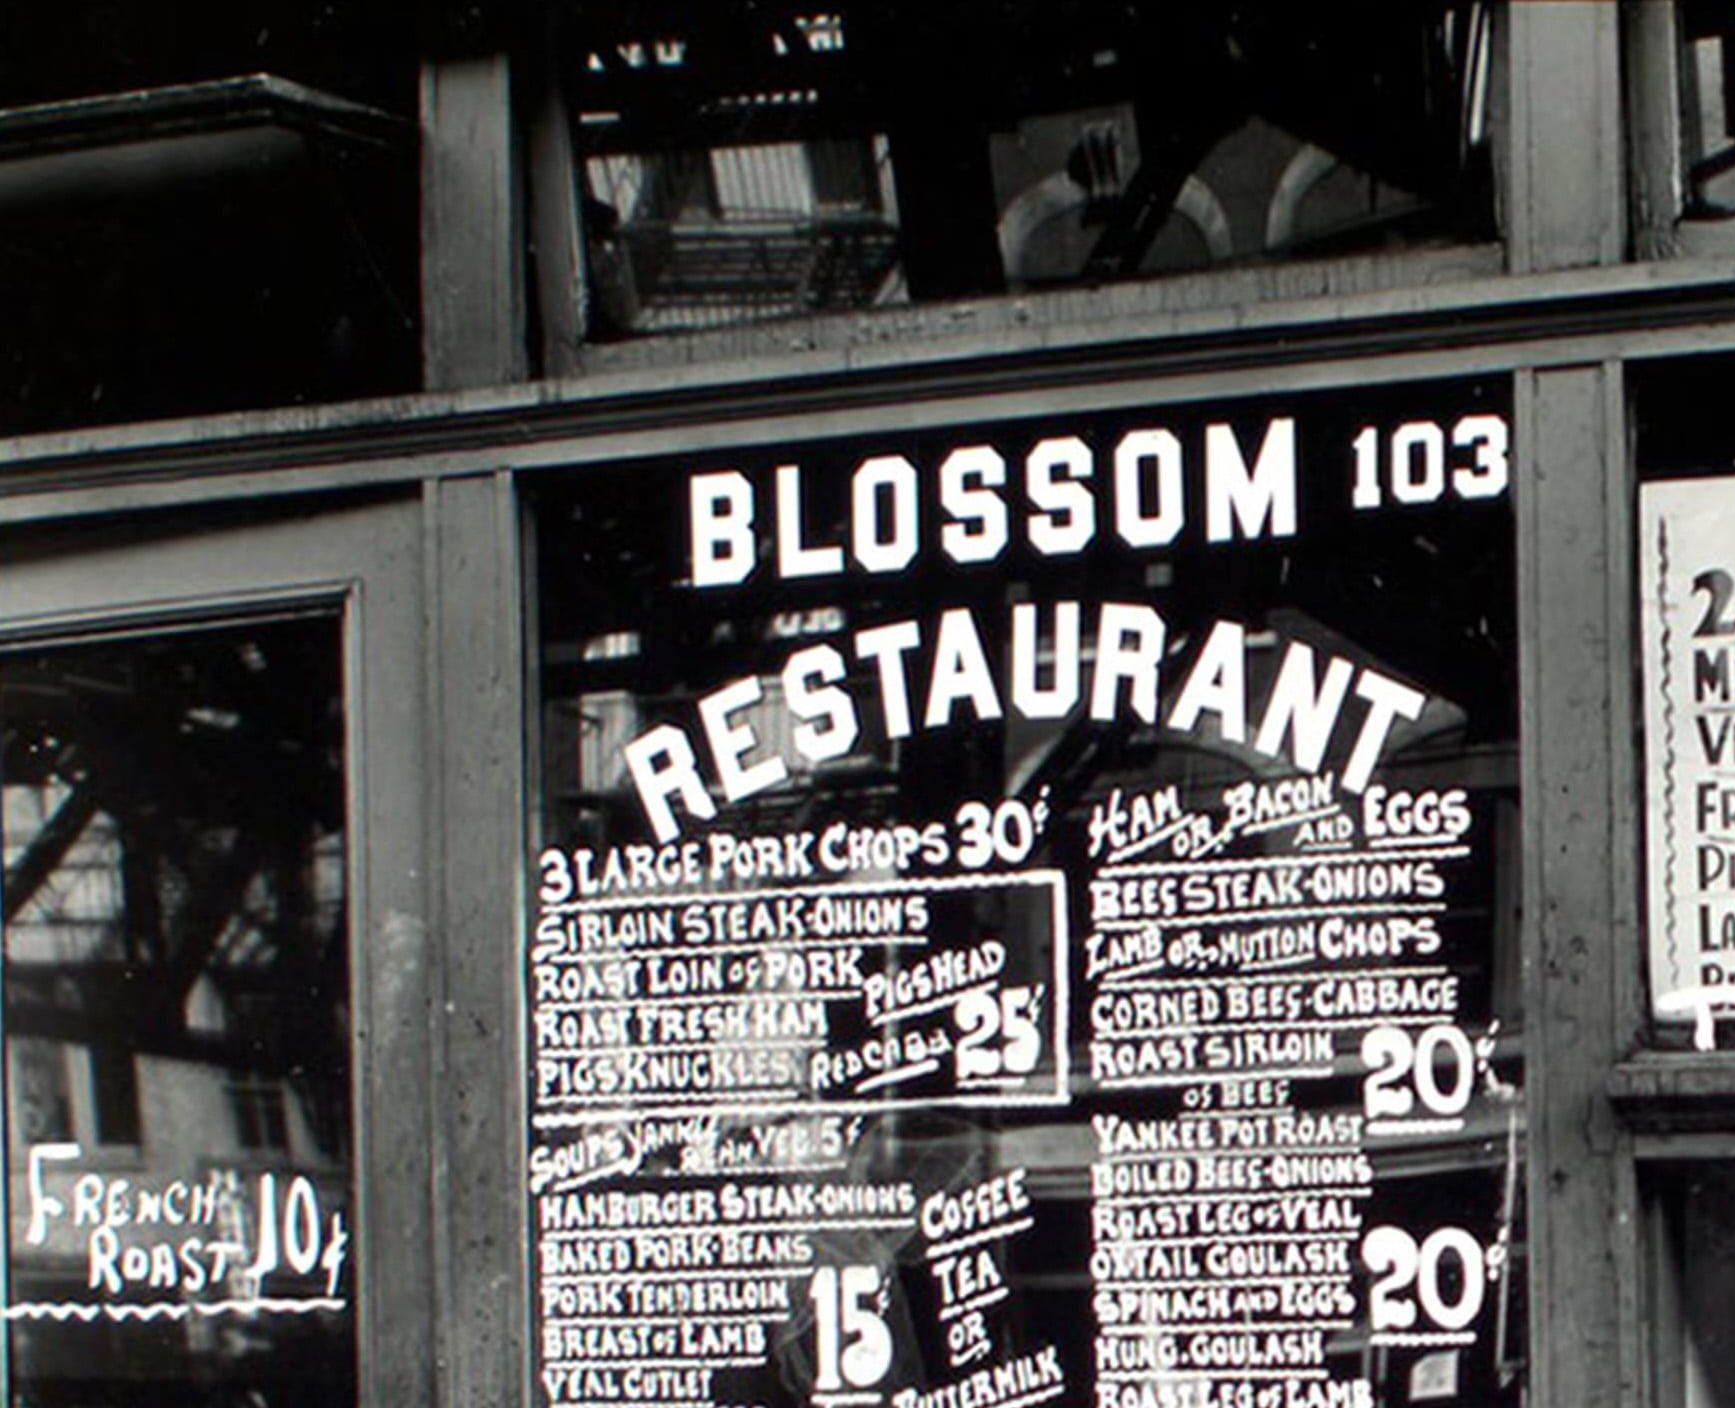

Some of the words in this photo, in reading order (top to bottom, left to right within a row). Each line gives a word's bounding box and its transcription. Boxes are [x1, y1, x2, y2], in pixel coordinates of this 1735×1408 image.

[689, 417, 1297, 587] BLOSSOM
[1353, 415, 1508, 509] 103
[624, 601, 1425, 844] RESTAURANT
[1089, 785, 1181, 857] HAM
[1224, 771, 1335, 830] BACON
[1363, 785, 1471, 836] EGGS
[540, 849, 573, 900] 3
[575, 844, 700, 895] LARGE
[709, 832, 812, 880] PORK
[820, 821, 950, 871] CHOPS
[533, 912, 674, 962] SIRLOIN
[1085, 928, 1162, 980] LAMB
[1219, 922, 1315, 967] MUTTON
[1318, 916, 1442, 959] CHOPS
[534, 957, 640, 1002] ROAST
[648, 955, 721, 992] LOIN
[762, 948, 863, 988] PORK
[535, 1005, 627, 1047] ROAST
[639, 999, 750, 1041] FRESH
[750, 999, 828, 1038] HAM
[1090, 988, 1220, 1032] CORNED
[538, 1056, 617, 1093] PIGS
[621, 1049, 789, 1088] KNUCKLES
[1090, 1037, 1197, 1080] ROAST
[1204, 1030, 1333, 1069] SIRLOIN
[1092, 1115, 1215, 1154] YANKEE
[1220, 1117, 1269, 1147] POT
[1273, 1113, 1364, 1145] ROAST
[26, 1143, 215, 1245] FRENCH
[541, 1187, 717, 1229] HAMBURGER
[921, 1168, 1030, 1238] COFFEE
[89, 1225, 245, 1293] ROAST
[245, 1172, 348, 1297] 10¢
[1092, 1205, 1192, 1240] ROAST
[1198, 1203, 1250, 1234] LEG
[1279, 1199, 1361, 1231] VEAL
[541, 1240, 629, 1273] BAKED
[933, 1250, 1001, 1303] TEA
[1205, 1241, 1351, 1276] GOULASH
[542, 1285, 621, 1316] PORK
[626, 1280, 788, 1313] TENDERLOIN
[1093, 1290, 1230, 1324] SPINACH
[1280, 1281, 1356, 1316] EGGS
[542, 1325, 652, 1360] BREAST
[680, 1322, 765, 1355] LAMB
[1189, 1330, 1323, 1366] GOULASH
[543, 1369, 621, 1400] VEAL
[626, 1369, 712, 1399] CUTLET
